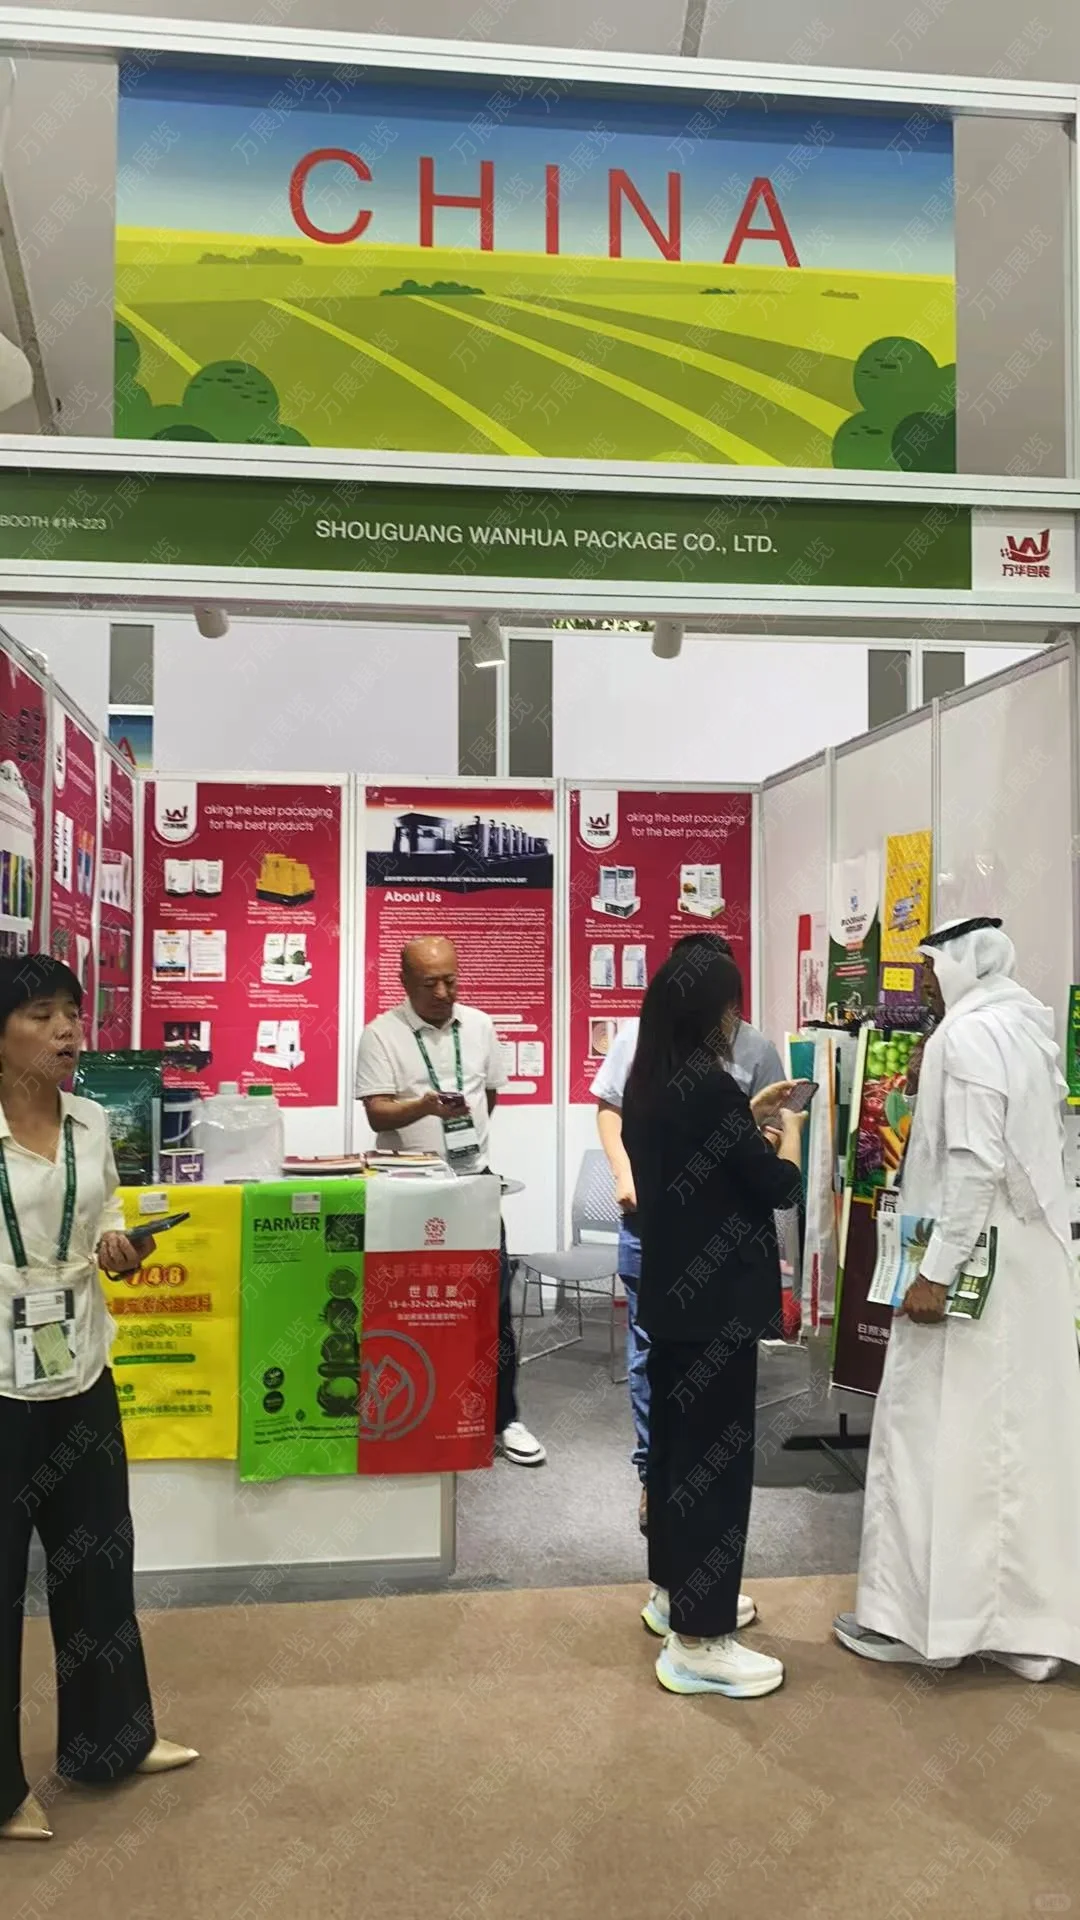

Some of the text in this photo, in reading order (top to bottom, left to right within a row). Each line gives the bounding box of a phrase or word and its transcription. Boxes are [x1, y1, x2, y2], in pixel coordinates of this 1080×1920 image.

[289, 148, 801, 268] CHINA
[315, 520, 778, 553] SHOUGUANG WANHUA PACKAGE CO., LTD.
[384, 891, 442, 904] About Us
[253, 1216, 321, 1233] FARMER
